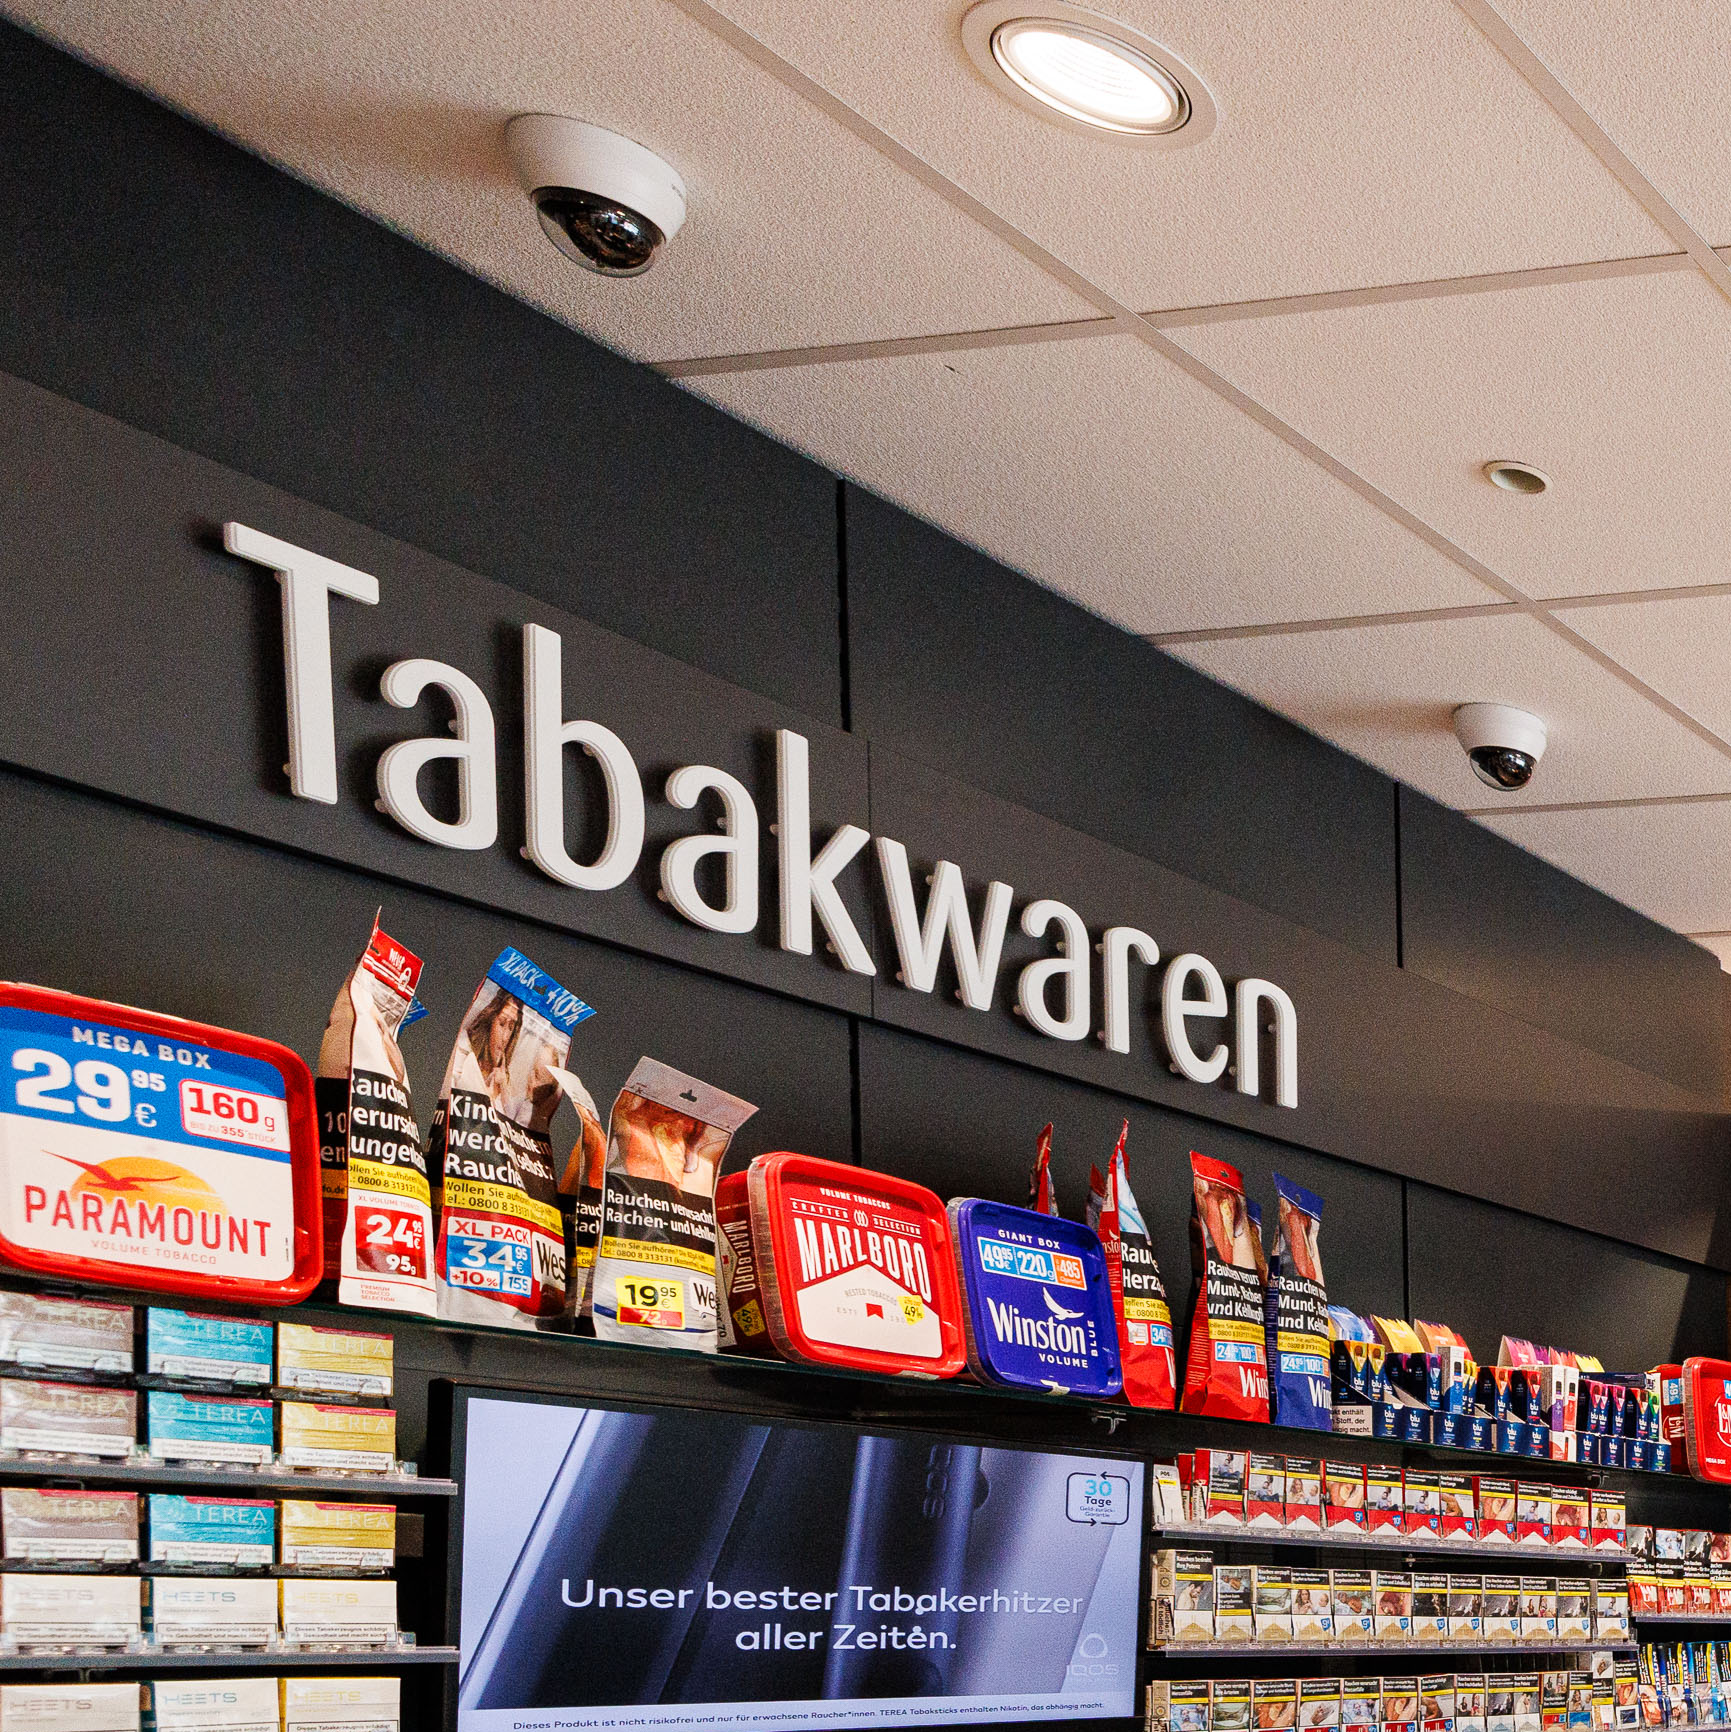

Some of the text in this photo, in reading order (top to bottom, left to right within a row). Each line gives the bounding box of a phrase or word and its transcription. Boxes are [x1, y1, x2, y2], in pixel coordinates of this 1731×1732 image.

[223, 520, 1299, 1111] Tabakwaren
[72, 1026, 212, 1070] MEGA BOX
[12, 1048, 166, 1122] 29 95
[188, 1087, 259, 1124] 160
[469, 1197, 499, 1209] 0800
[607, 1189, 669, 1212] Rauchen
[24, 1185, 271, 1258] PARAMOUNT
[366, 1214, 414, 1249] 24
[454, 1220, 528, 1245] XL PACK
[606, 1208, 668, 1229] Rachen-
[792, 1202, 921, 1235] CRAFTED SELECTION
[91, 1240, 217, 1265] VOLUME TOBACCO
[998, 1229, 1060, 1250] GIANT BOX
[461, 1240, 517, 1272] 34
[722, 1220, 756, 1293] MARLBORO
[794, 1217, 932, 1304] MARLBORO
[1017, 1251, 1080, 1279] 220 485
[508, 1276, 528, 1291] 155
[624, 1284, 677, 1306] 19 95
[987, 1297, 1087, 1355] Winston
[1087, 1320, 1099, 1357] BLUE
[1038, 1353, 1089, 1368] VOLUME
[1084, 1496, 1112, 1507] Tage
[1085, 1479, 1113, 1497] 30
[560, 1577, 1083, 1616] Unser bester Tabakerhitzer
[735, 1624, 957, 1653] aller Zeiten.
[1066, 1664, 1119, 1676] IQOS
[513, 1722, 550, 1730] Dieses
[554, 1719, 598, 1729] Produkt
[619, 1718, 646, 1726] nicht
[649, 1716, 694, 1725] risikofrei
[696, 1716, 715, 1724] und
[736, 1714, 750, 1722] für
[752, 1713, 809, 1721] erwachsene
[910, 1707, 958, 1715] Tabaksticks
[960, 1706, 998, 1714] enthalten
[1046, 1703, 1078, 1712] abhängig
[1080, 1702, 1104, 1710] macht.
